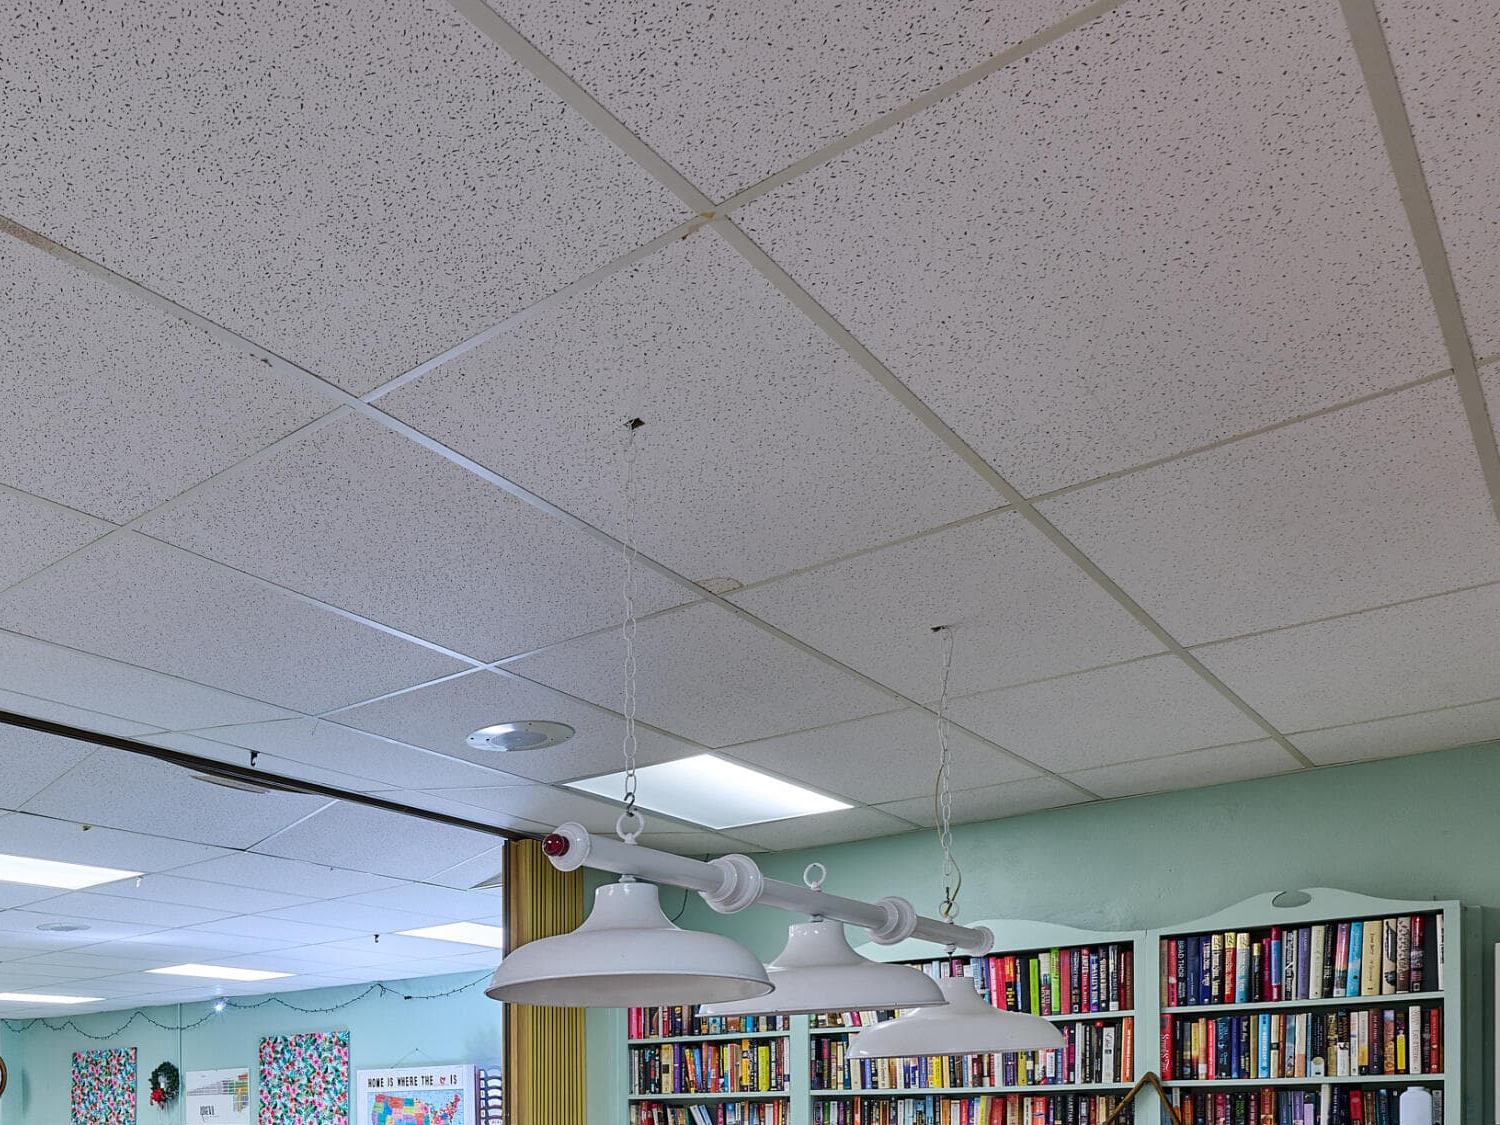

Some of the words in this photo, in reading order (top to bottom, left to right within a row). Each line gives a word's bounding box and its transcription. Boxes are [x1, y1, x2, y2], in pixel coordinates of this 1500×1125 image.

[367, 1077, 384, 1088] HOME
[387, 1076, 394, 1087] IS
[397, 1075, 418, 1087] WHERE
[421, 1075, 433, 1086] THE
[450, 1074, 457, 1085] IS
